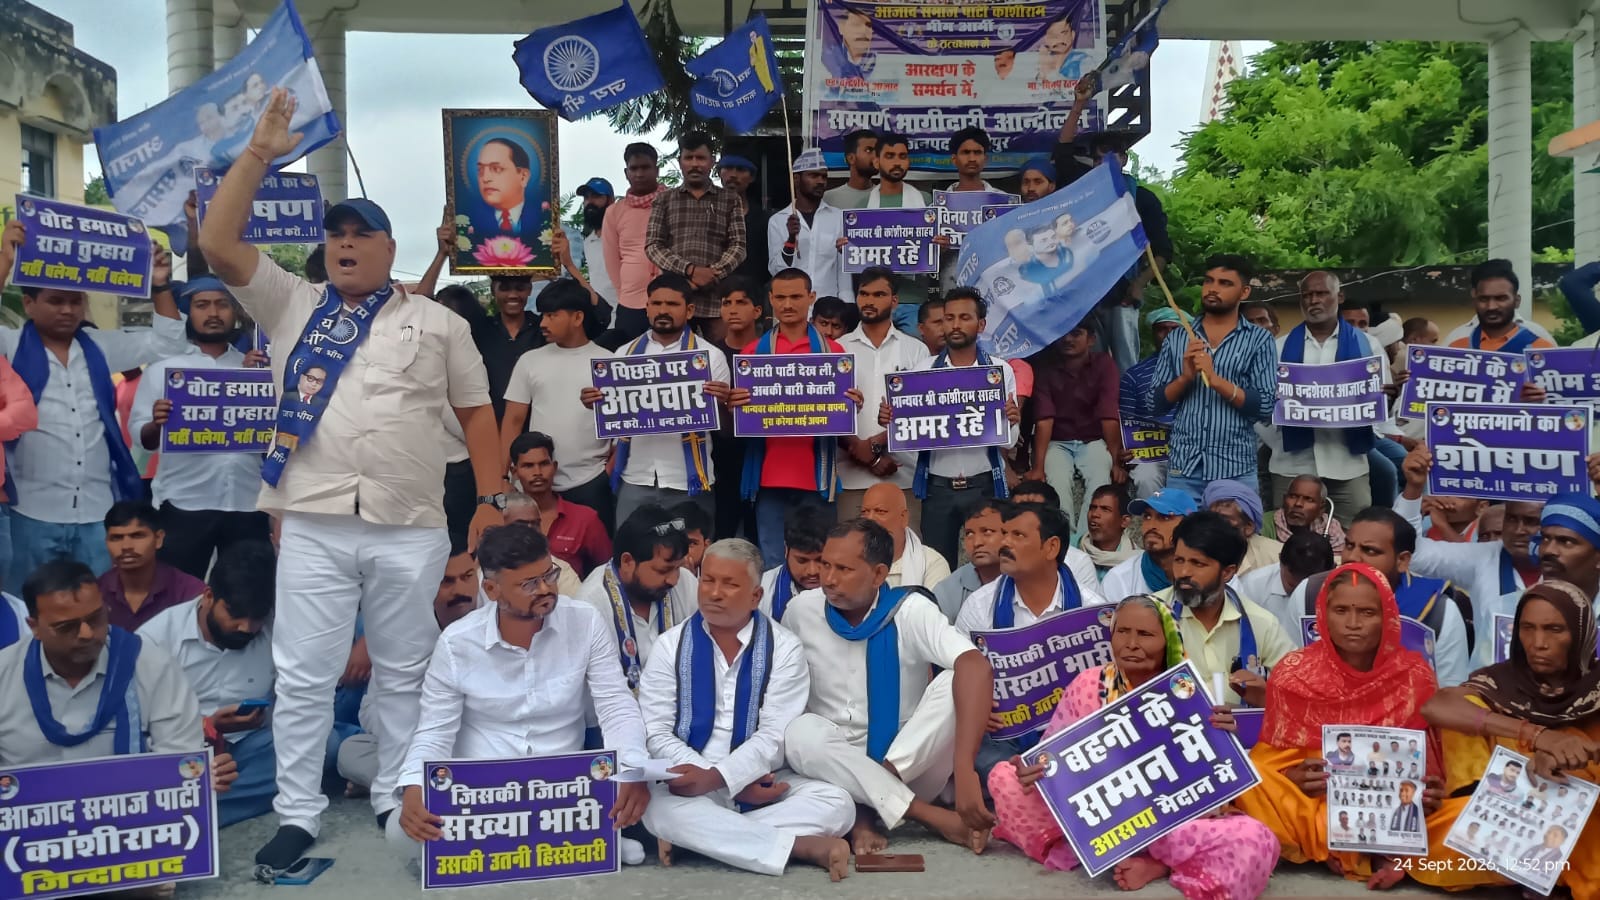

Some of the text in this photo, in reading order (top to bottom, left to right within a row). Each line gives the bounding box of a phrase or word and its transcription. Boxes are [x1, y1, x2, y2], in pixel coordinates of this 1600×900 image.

[905, 60, 976, 77] आरक्षण के
[912, 80, 958, 97] समर्थन
[896, 108, 988, 133] भागीदारी
[38, 208, 73, 230] वोट
[77, 217, 128, 238] हमारा
[36, 235, 136, 263] राज तुम्हारा
[848, 245, 893, 266] अमर
[897, 239, 921, 265] रहें
[20, 259, 44, 277] नहीं
[86, 266, 109, 284] नहीं
[665, 360, 688, 376] पर
[752, 362, 836, 378] सारी पार्टी देख ली,
[1428, 353, 1507, 378] बहनों के
[186, 376, 274, 397] वोट हमारा
[752, 381, 836, 396] अबकी बारी केतली
[1295, 380, 1335, 399] चन्द्रशेखर
[1336, 380, 1366, 398] आजाद
[1368, 374, 1380, 393] जी
[1492, 380, 1516, 403] में
[1534, 369, 1586, 392] भीम
[891, 388, 1001, 408] मान्यवर श्री कांशीराम साहब
[1283, 399, 1377, 422] जिन्दाबाद
[181, 405, 277, 427] राज तुम्हारा
[895, 415, 950, 441] अमर
[955, 405, 985, 437] रहें
[1452, 410, 1561, 435] मुसलमानो का
[168, 427, 191, 445] नहीं
[233, 428, 255, 443] नहीं
[1435, 437, 1580, 477] शोषण
[988, 624, 1104, 670] जिसकी जितनी
[1000, 703, 1032, 727] सकी
[1059, 692, 1175, 773] बहनों के
[1068, 713, 1217, 827] सम्मन में
[451, 776, 592, 806] जिसकी जितनी
[0, 779, 201, 832] आजाद समाज पार्टी
[1089, 806, 1158, 857] आसपा
[1213, 759, 1238, 784] में
[441, 798, 603, 841] संख्या भारी
[436, 838, 608, 876] उसकी उतनी हिस्सेदारी
[21, 855, 187, 895] जिन्दाबाद
